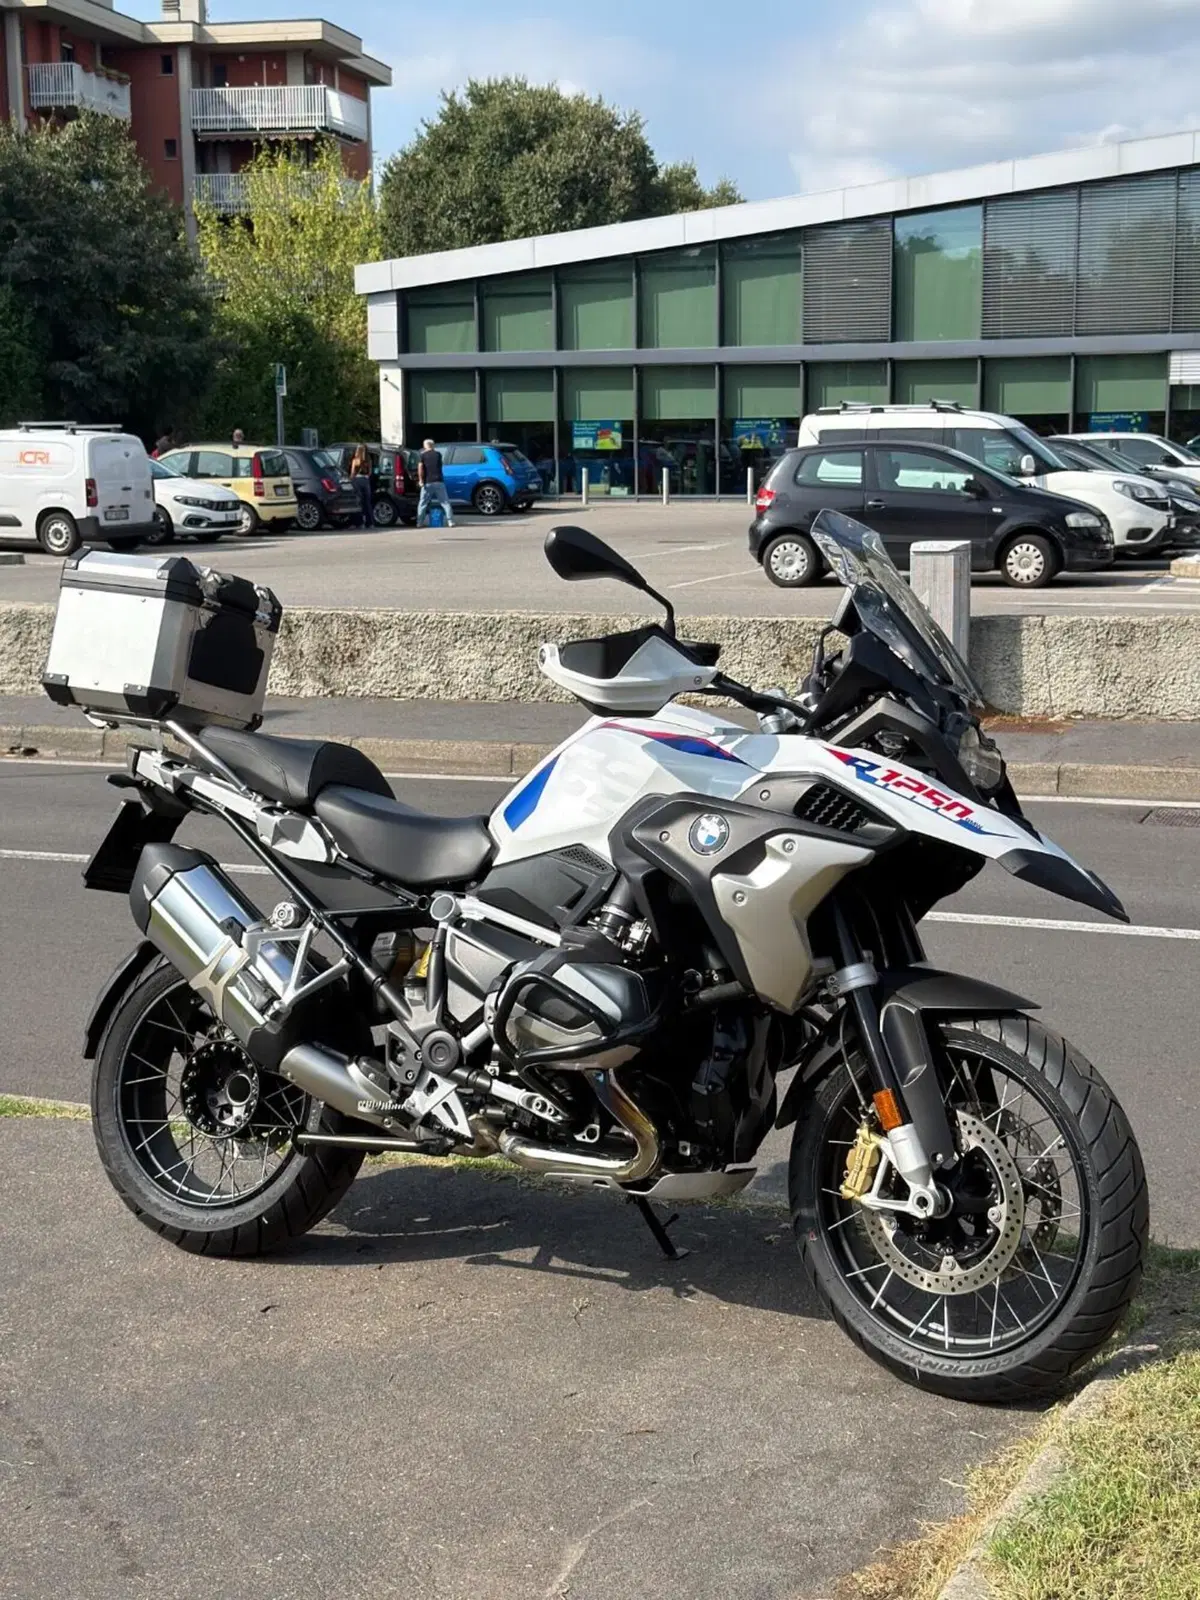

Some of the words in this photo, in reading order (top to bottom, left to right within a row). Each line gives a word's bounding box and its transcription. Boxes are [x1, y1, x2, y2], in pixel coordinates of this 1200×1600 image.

[19, 451, 51, 465] ICRI
[847, 756, 882, 784] R
[880, 769, 974, 821] 1250
